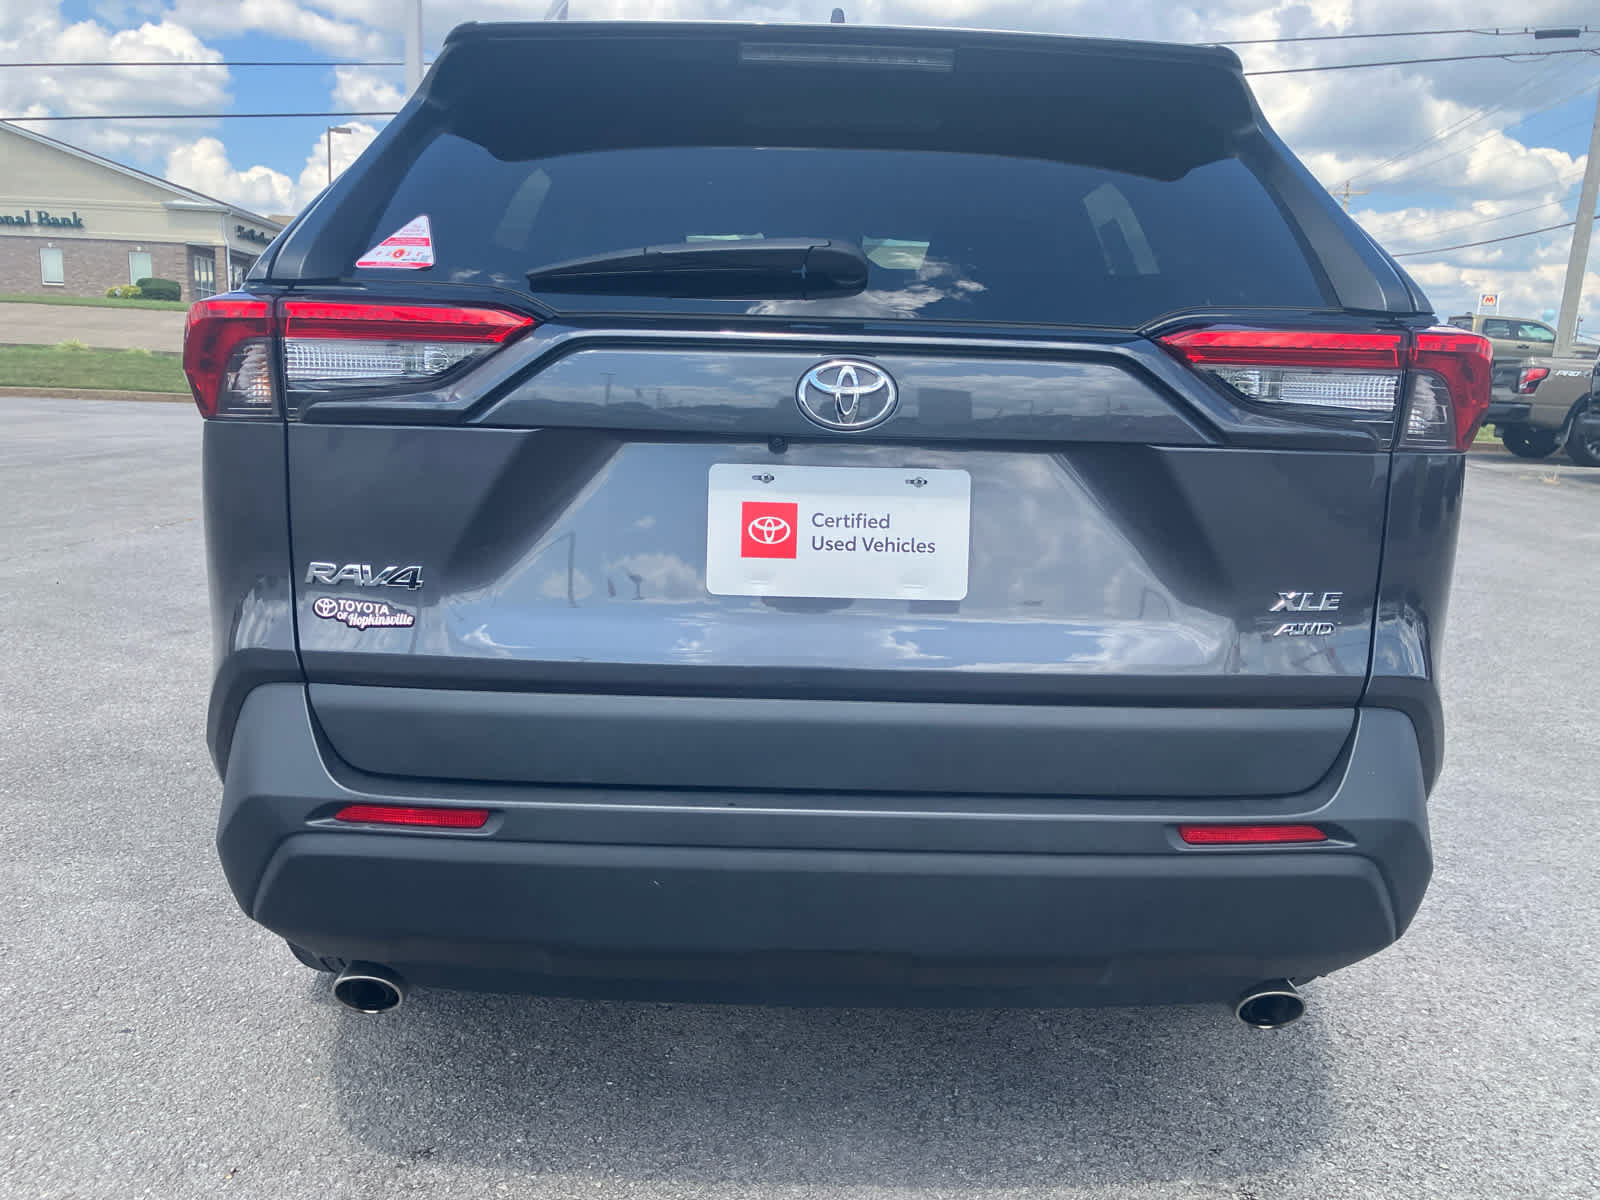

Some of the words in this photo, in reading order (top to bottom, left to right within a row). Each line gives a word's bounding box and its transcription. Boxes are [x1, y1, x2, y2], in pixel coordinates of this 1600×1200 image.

[37, 210, 85, 228] Bank
[811, 512, 891, 529] Certified
[811, 536, 857, 552] Used
[862, 537, 936, 554] Vehicles
[304, 561, 424, 590] RAV4
[338, 599, 390, 615] TOYOTA
[1268, 591, 1344, 611] XLE
[348, 612, 414, 629] Hopkinsville
[1272, 622, 1335, 636] AWD
